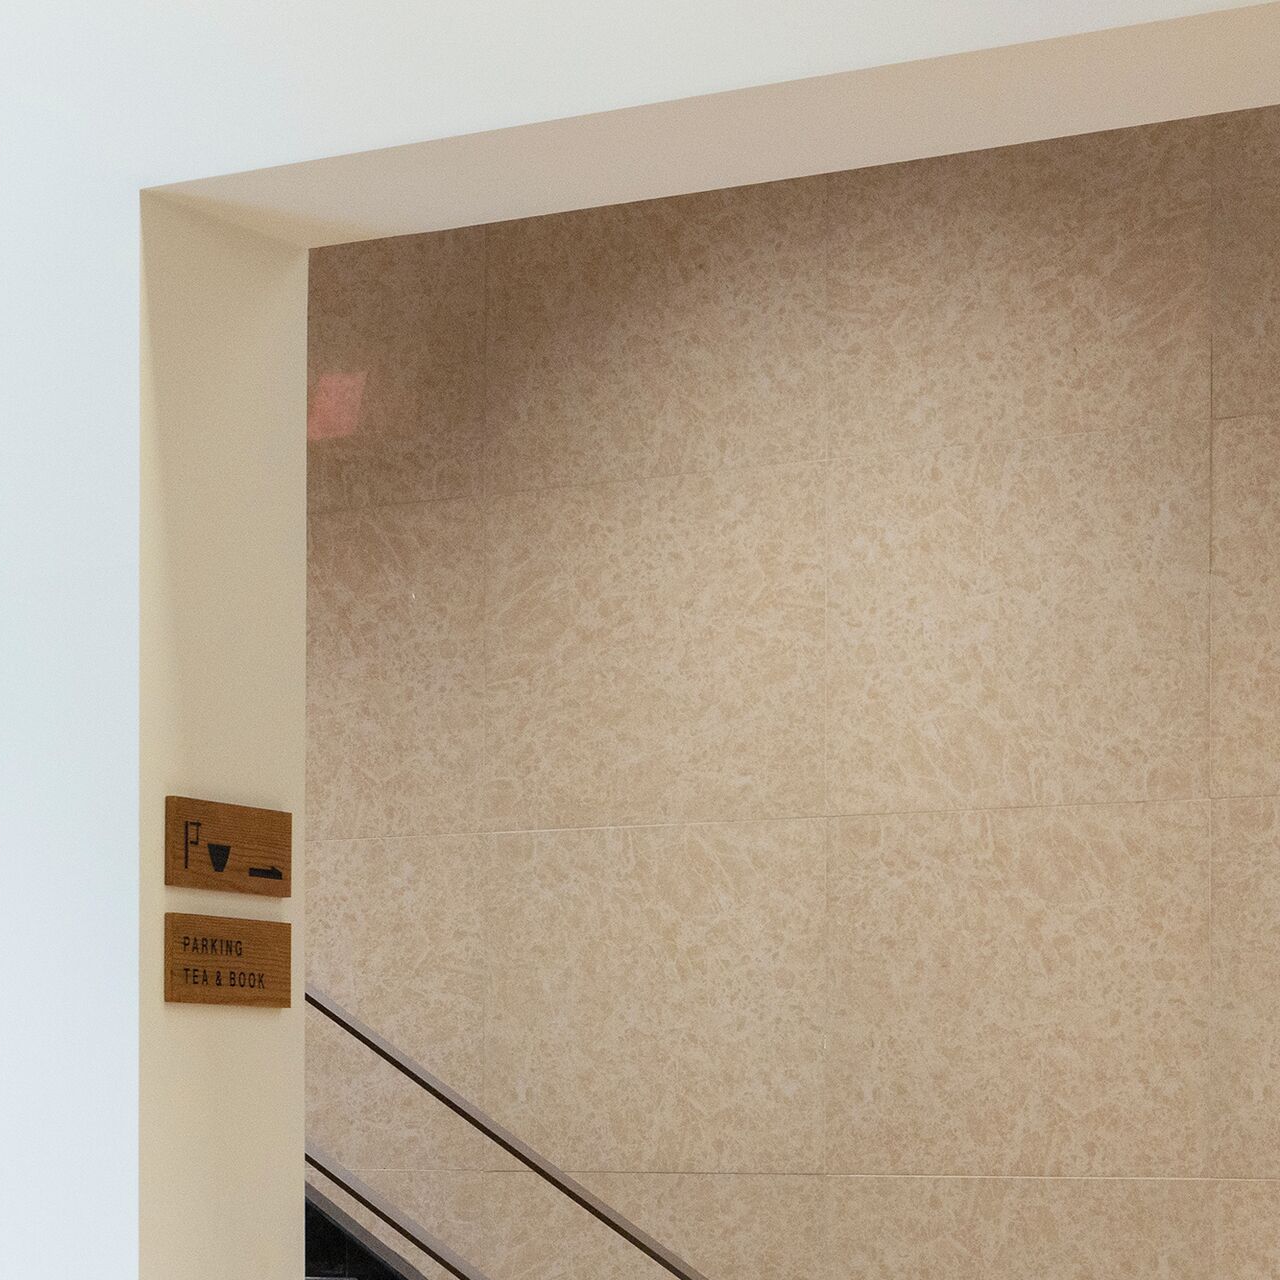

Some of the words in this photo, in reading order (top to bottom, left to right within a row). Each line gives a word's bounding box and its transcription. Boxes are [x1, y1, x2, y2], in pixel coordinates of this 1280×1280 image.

[182, 935, 244, 957] PARKING
[183, 968, 209, 985] TEA
[215, 970, 223, 987] &
[229, 971, 266, 989] BOOK
